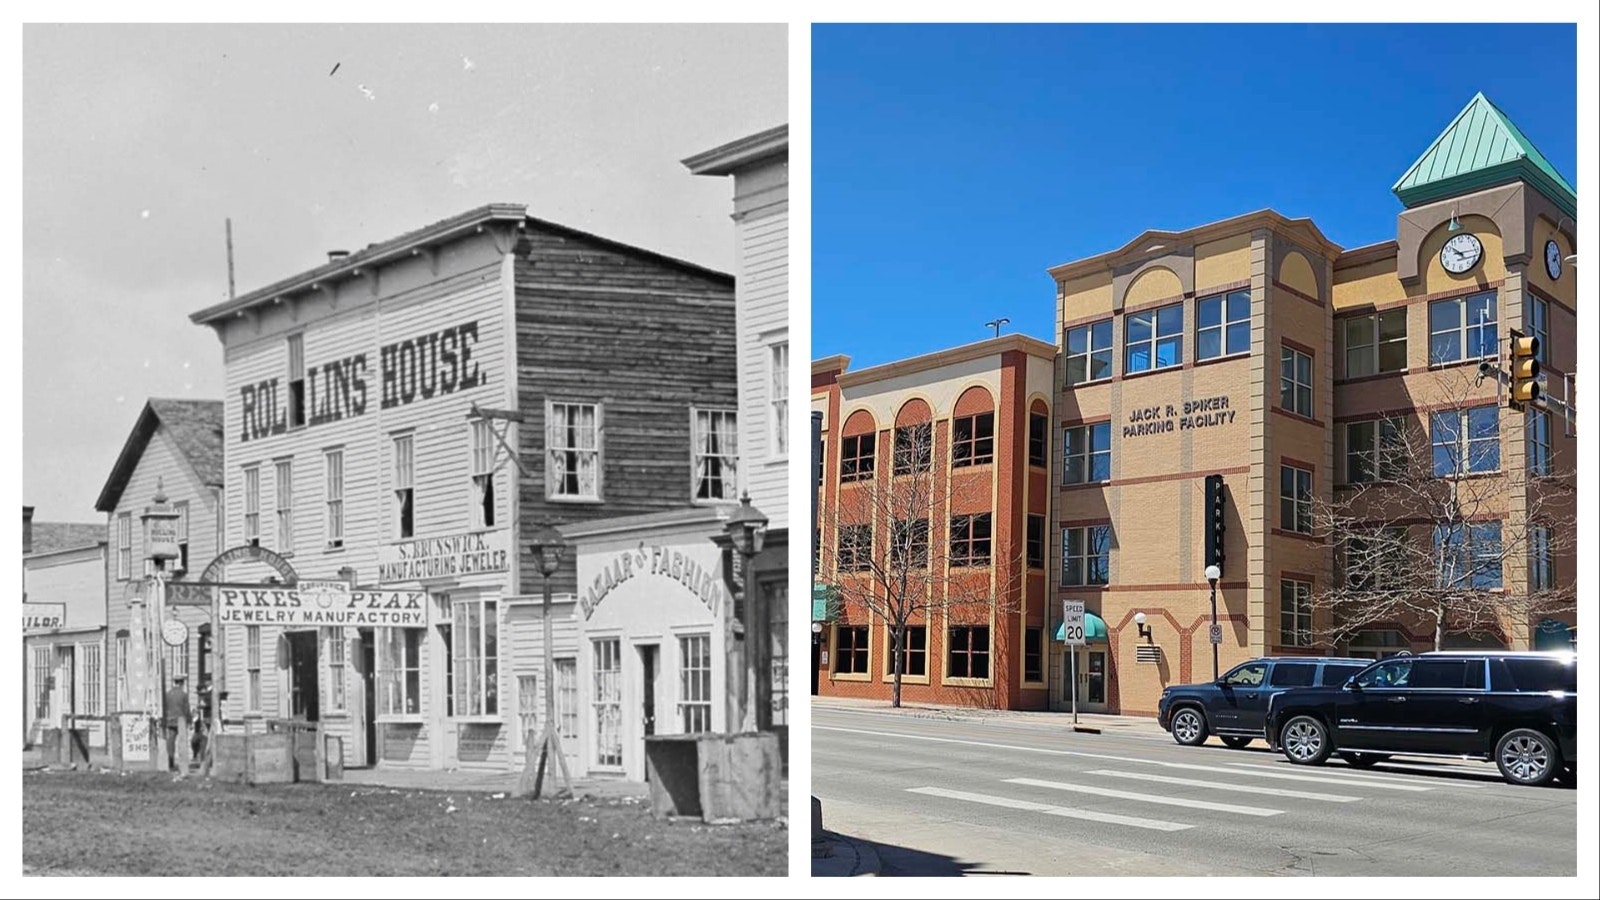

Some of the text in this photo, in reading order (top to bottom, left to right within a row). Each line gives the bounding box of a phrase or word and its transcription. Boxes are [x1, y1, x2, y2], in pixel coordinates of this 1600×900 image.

[380, 321, 486, 410] HOUSE.
[1129, 396, 1229, 423] JACK R. SPIKER
[1123, 410, 1236, 438] PARKING FACILITY
[380, 550, 510, 580] MANUFACTURING JEWELER.
[651, 546, 721, 617] FASHION
[221, 590, 423, 609] PIKES PEAK
[1066, 605, 1083, 613] SPEED
[22, 616, 62, 628] ILOR.
[221, 610, 425, 624] JEWELRY MANUFACTORY.
[1067, 626, 1083, 640] 20
